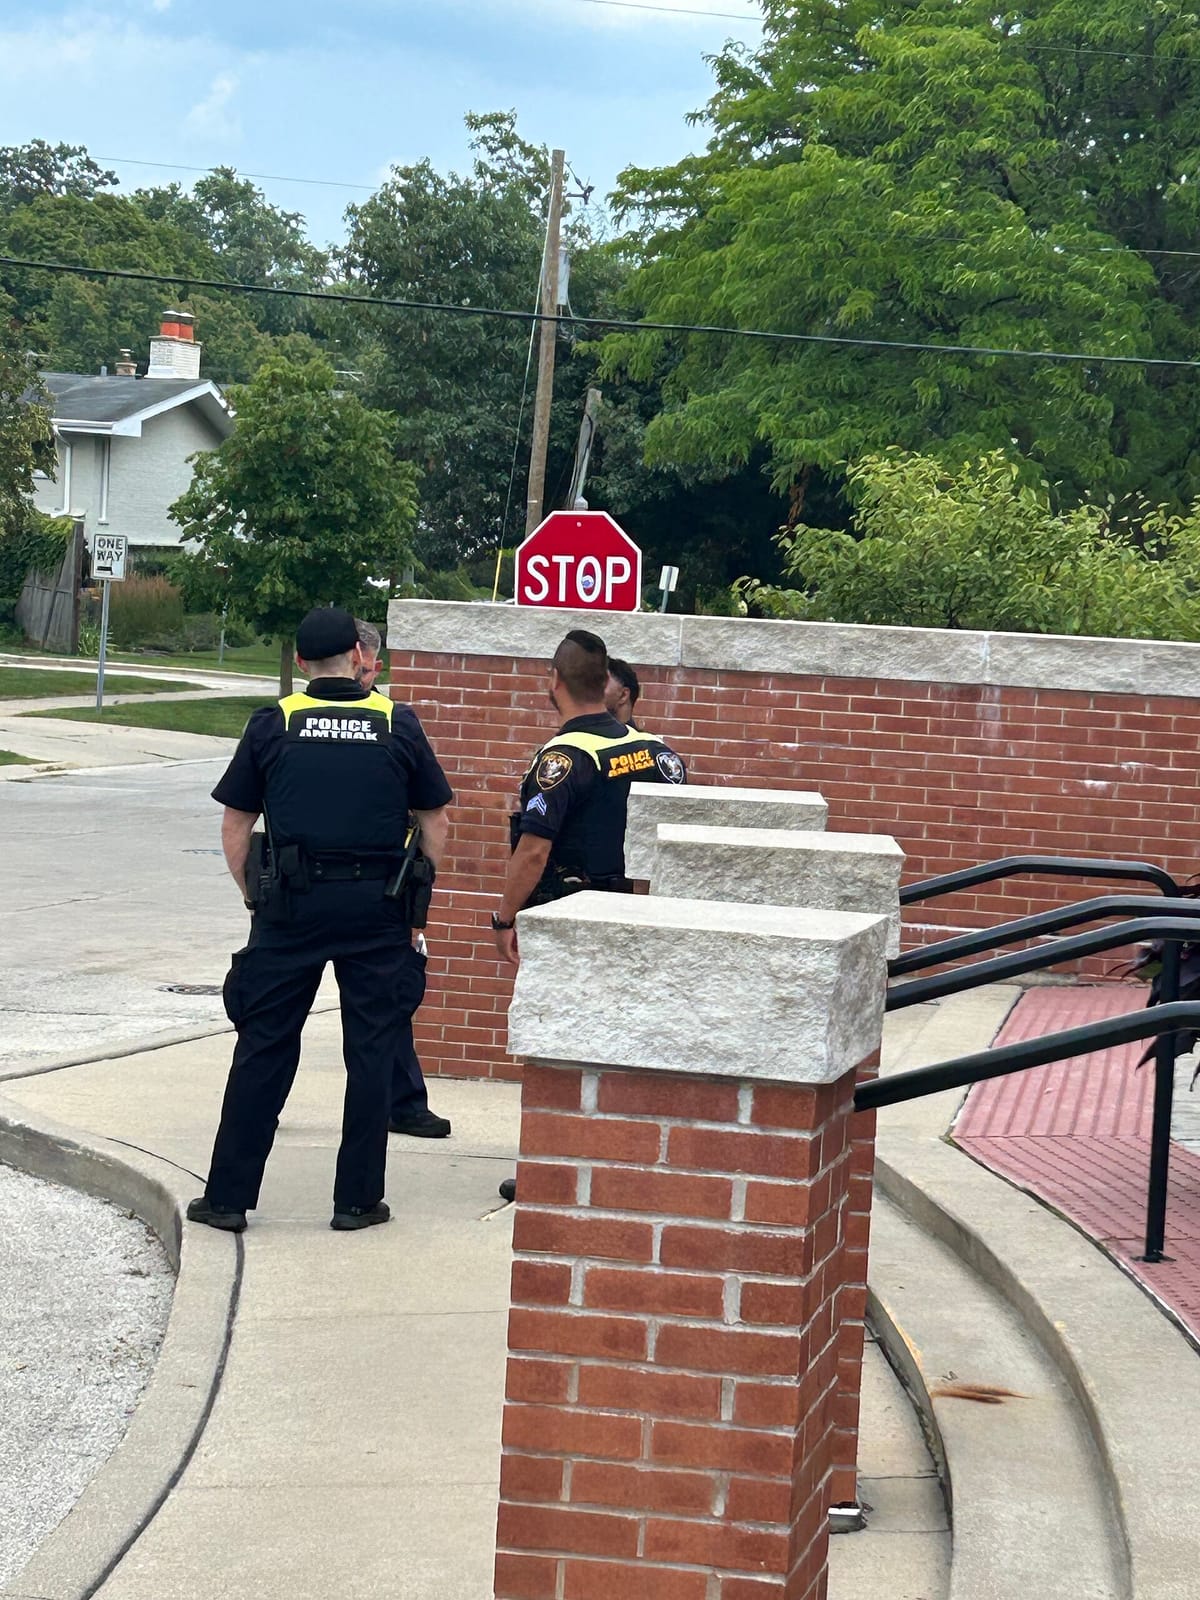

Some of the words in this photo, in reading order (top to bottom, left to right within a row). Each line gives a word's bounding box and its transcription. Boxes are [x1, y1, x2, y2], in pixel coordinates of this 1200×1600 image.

[98, 537, 123, 550] ONE
[97, 550, 122, 561] WAY
[524, 554, 631, 604] STOP
[306, 717, 372, 732] POLICE
